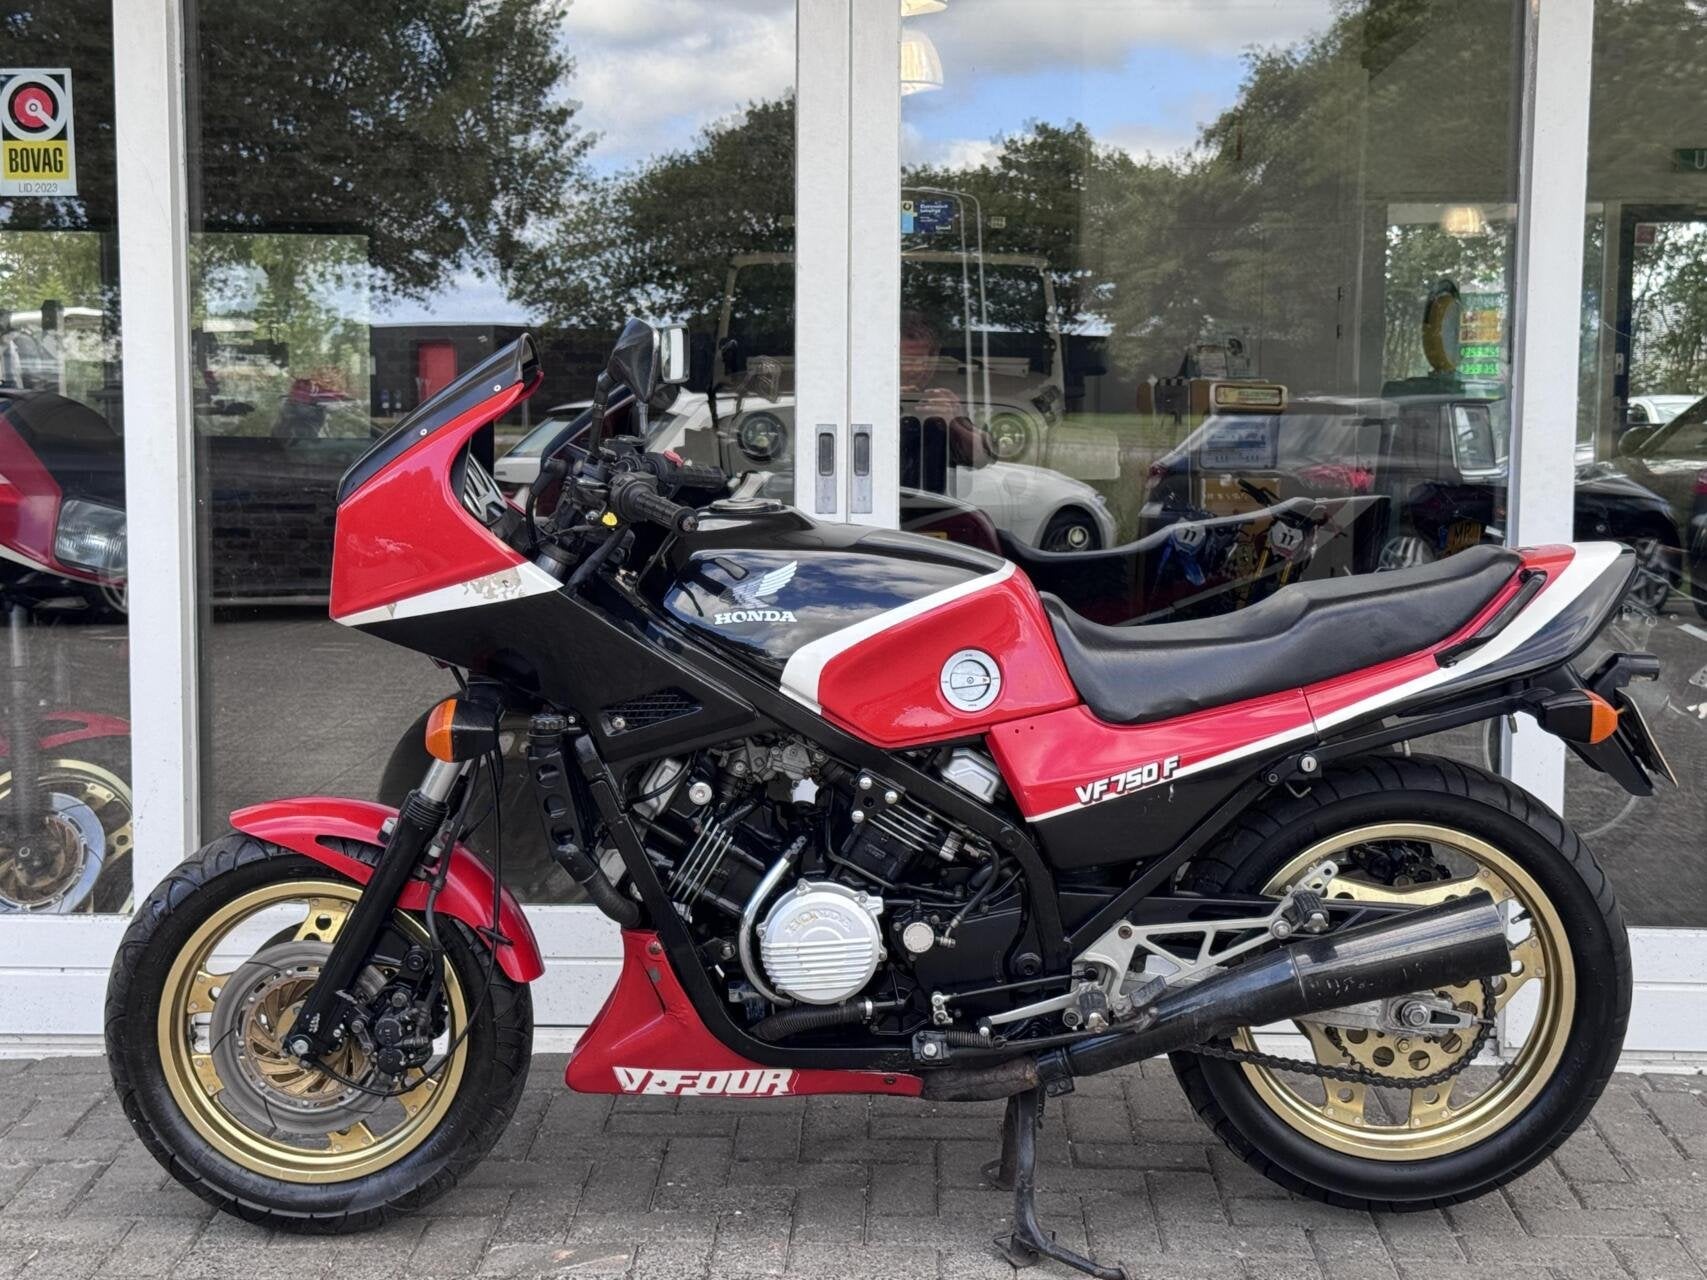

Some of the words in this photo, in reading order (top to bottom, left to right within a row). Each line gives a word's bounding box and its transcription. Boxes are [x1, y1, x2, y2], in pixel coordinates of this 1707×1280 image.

[8, 147, 64, 174] BOVAG
[18, 183, 33, 193] LID
[35, 183, 58, 193] 2023
[714, 610, 798, 625] HONDA
